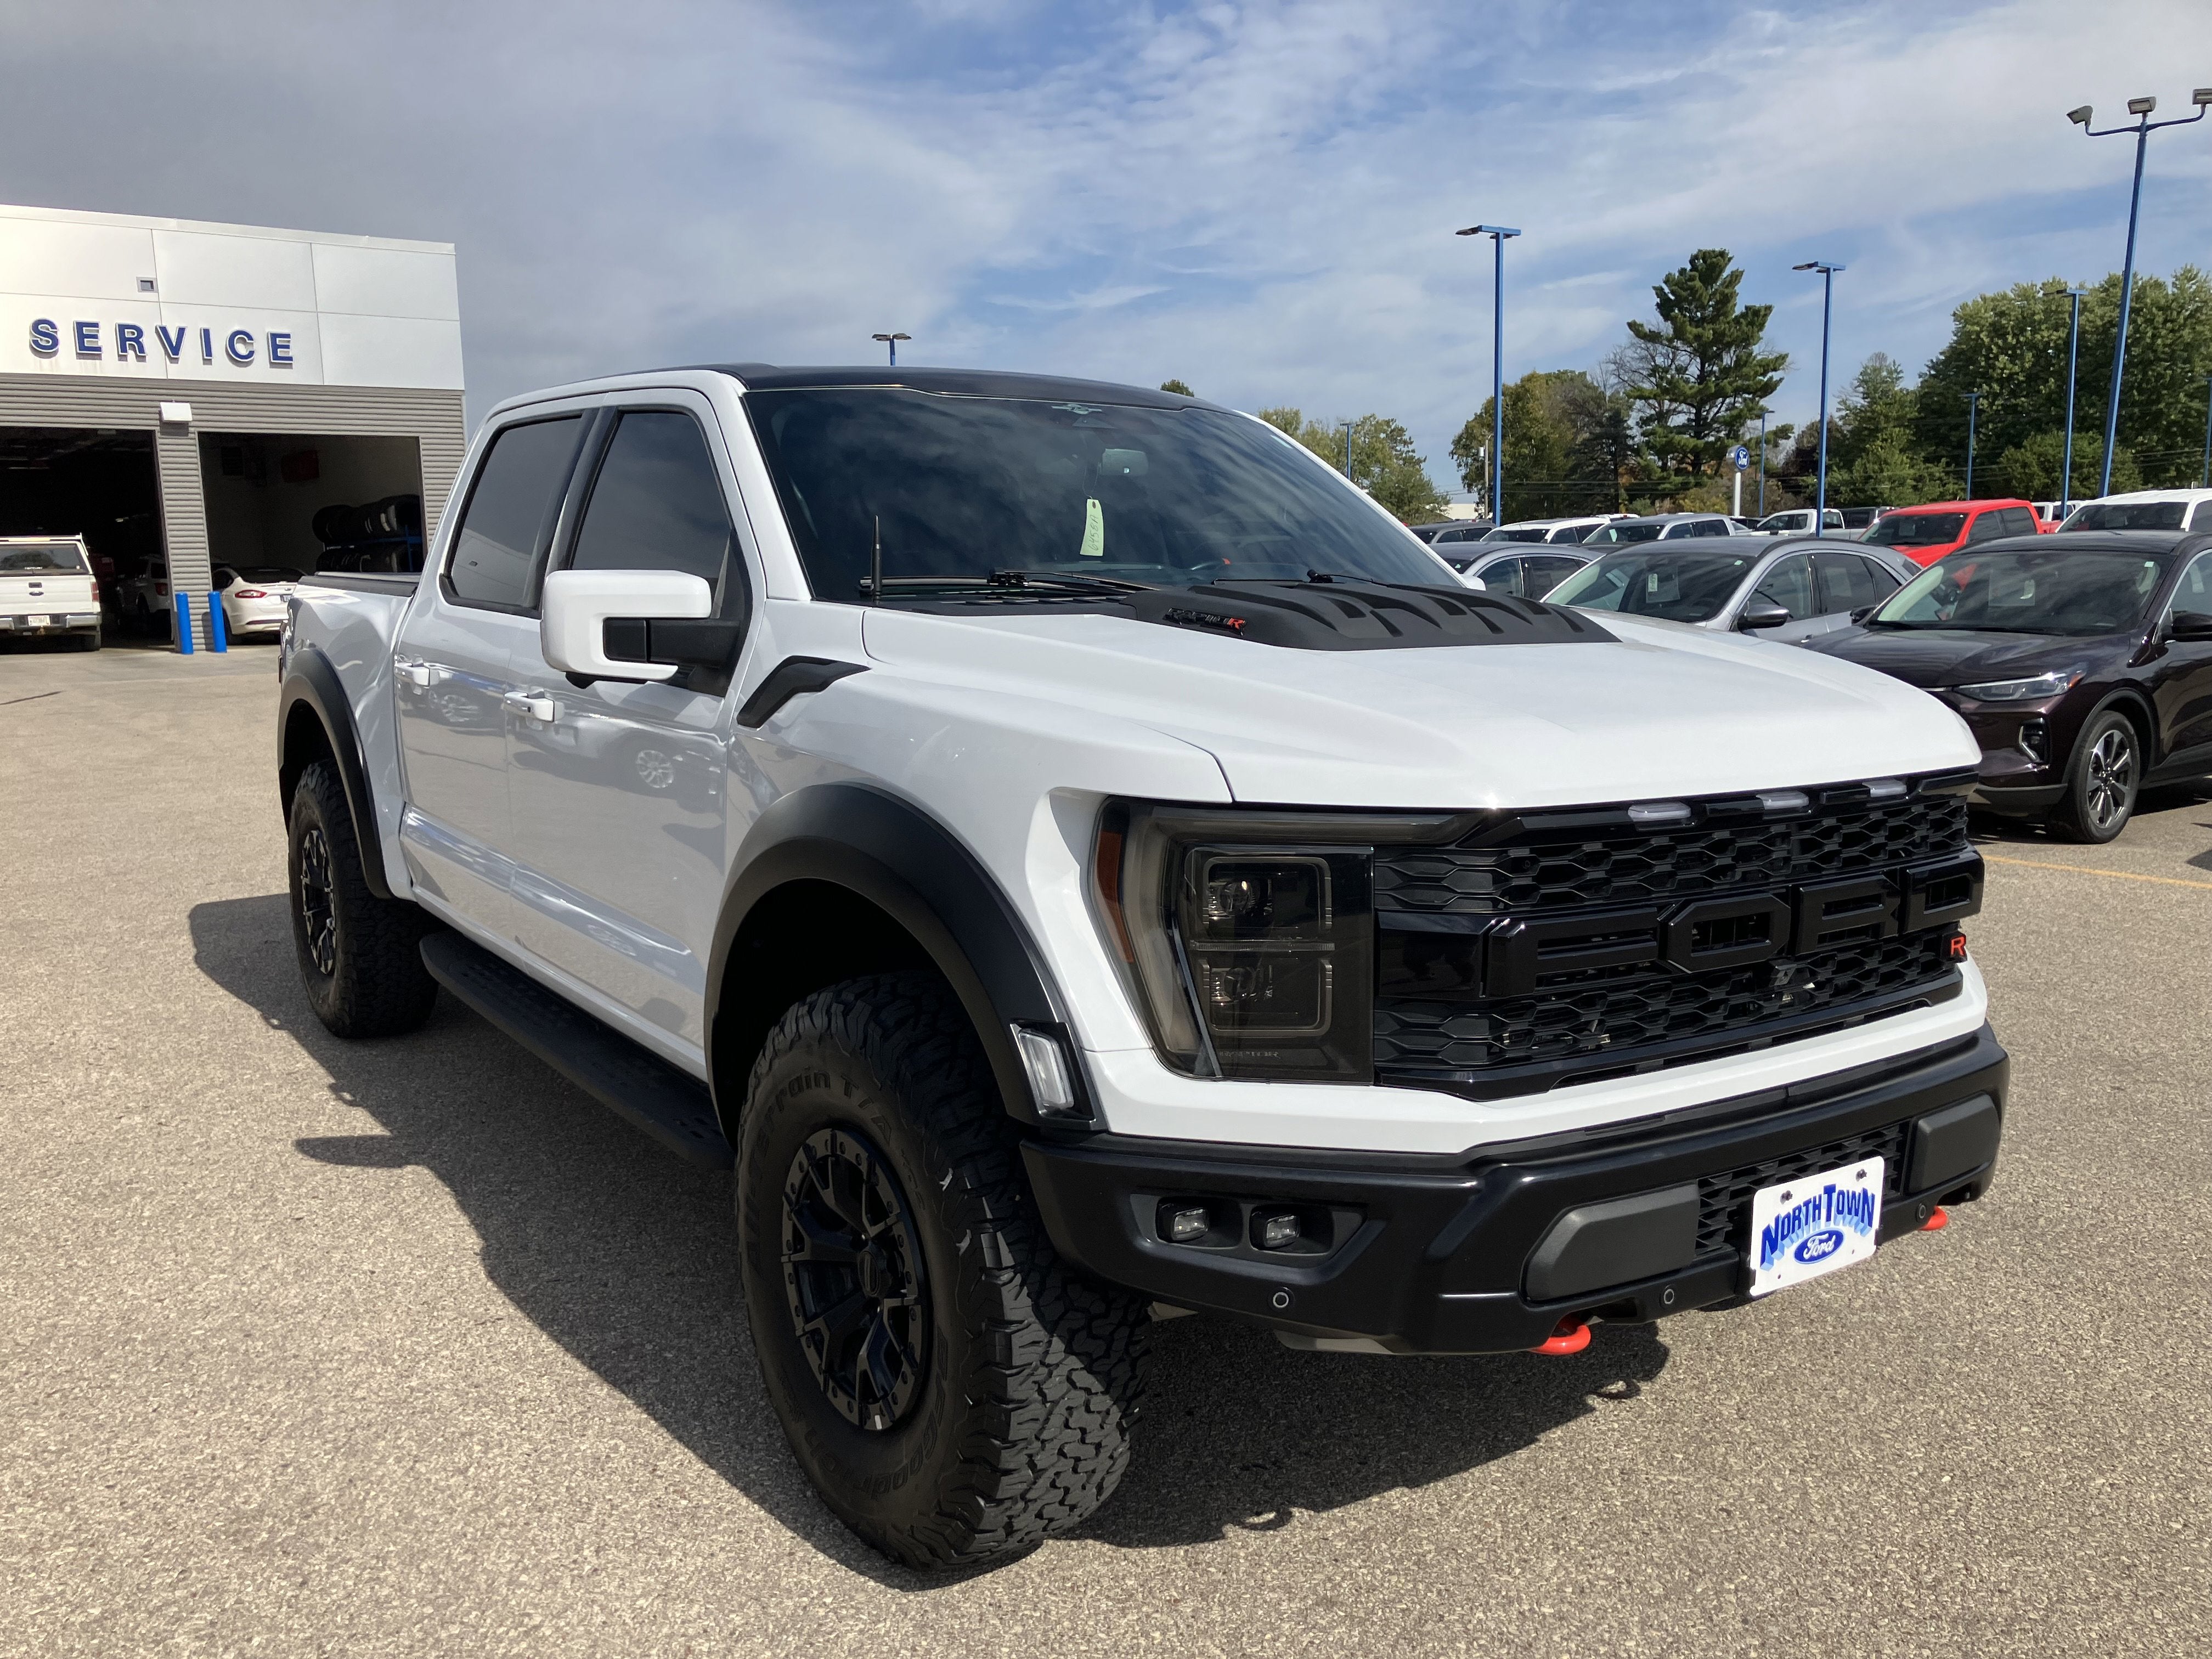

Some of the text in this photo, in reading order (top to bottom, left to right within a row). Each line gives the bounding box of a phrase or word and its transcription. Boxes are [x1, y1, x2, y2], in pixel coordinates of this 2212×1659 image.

[30, 318, 294, 363] SERVICE
[1488, 853, 1984, 998] FORD
[1950, 936, 1966, 956] R
[1803, 1233, 1836, 1260] Ford
